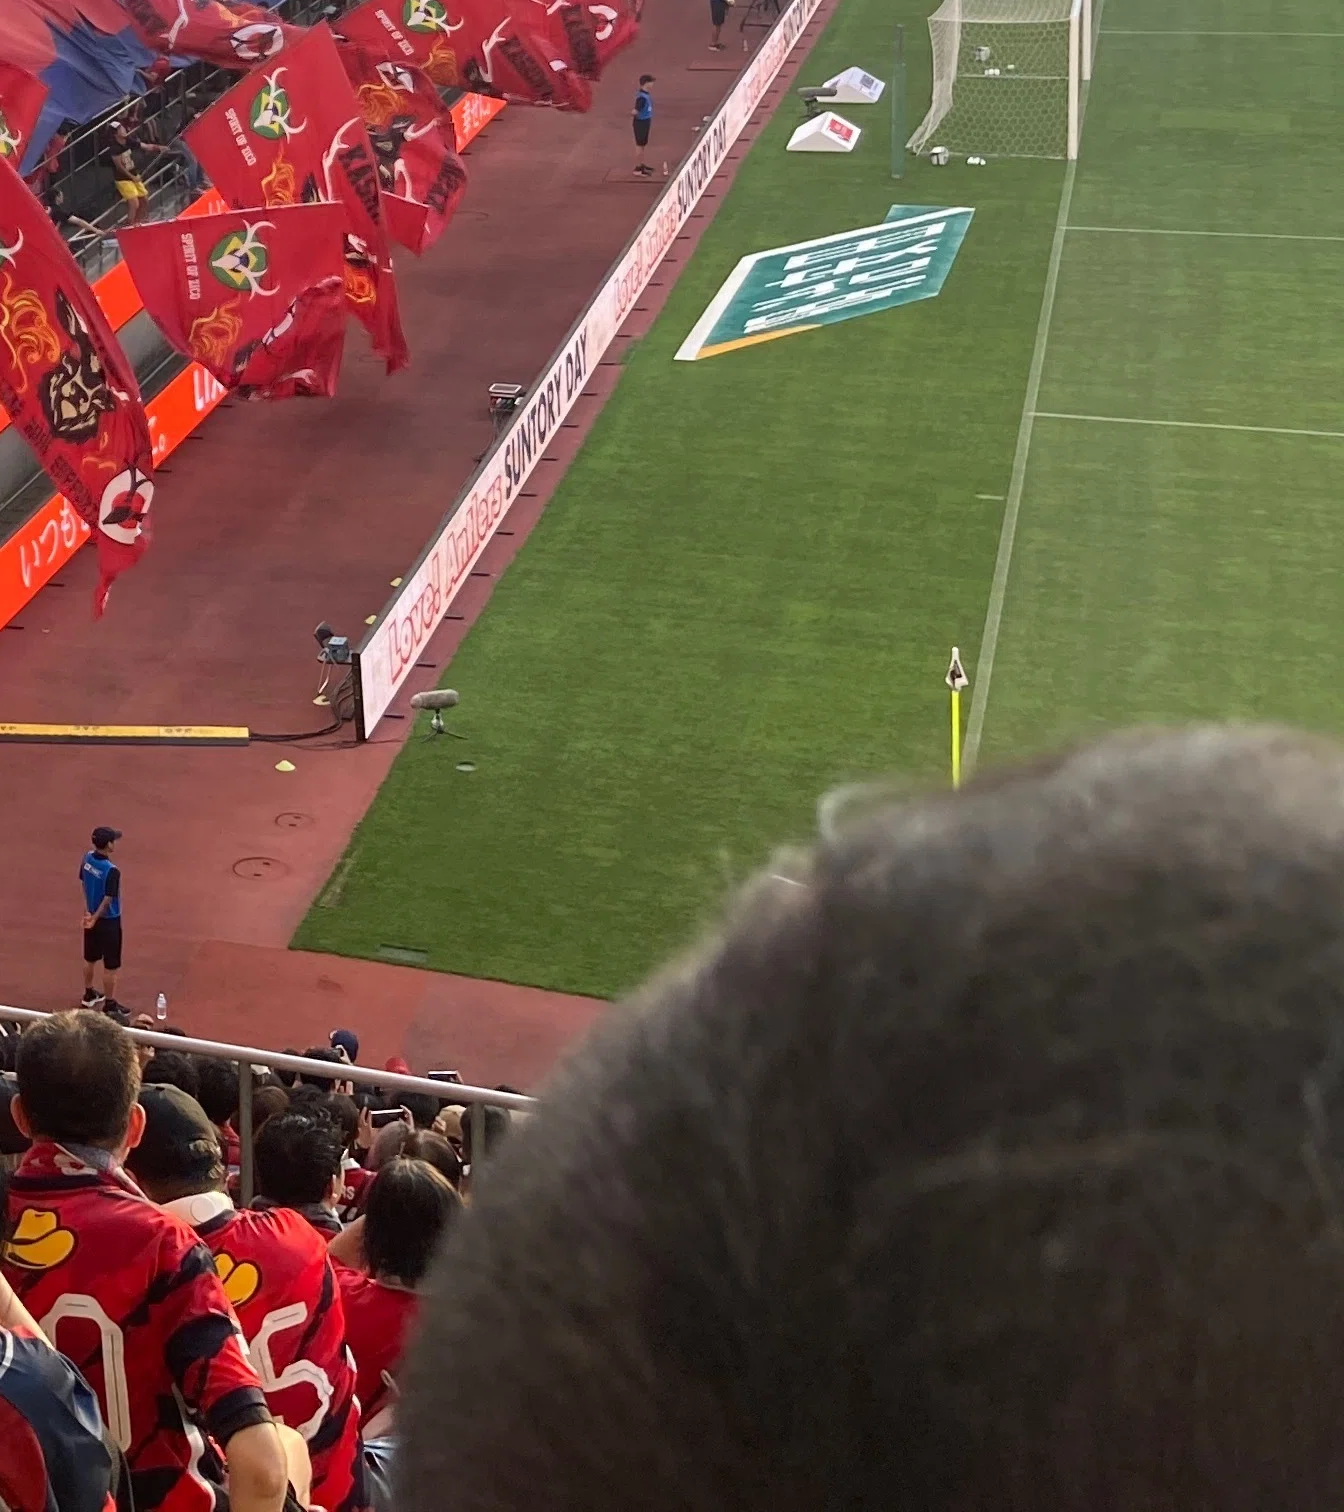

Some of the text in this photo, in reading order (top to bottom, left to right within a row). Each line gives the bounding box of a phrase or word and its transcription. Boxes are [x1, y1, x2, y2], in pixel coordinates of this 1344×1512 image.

[677, 143, 713, 223] SUNTORY
[711, 110, 728, 166] DAY
[387, 329, 588, 686] Love! Antlers SUNTORY DAY
